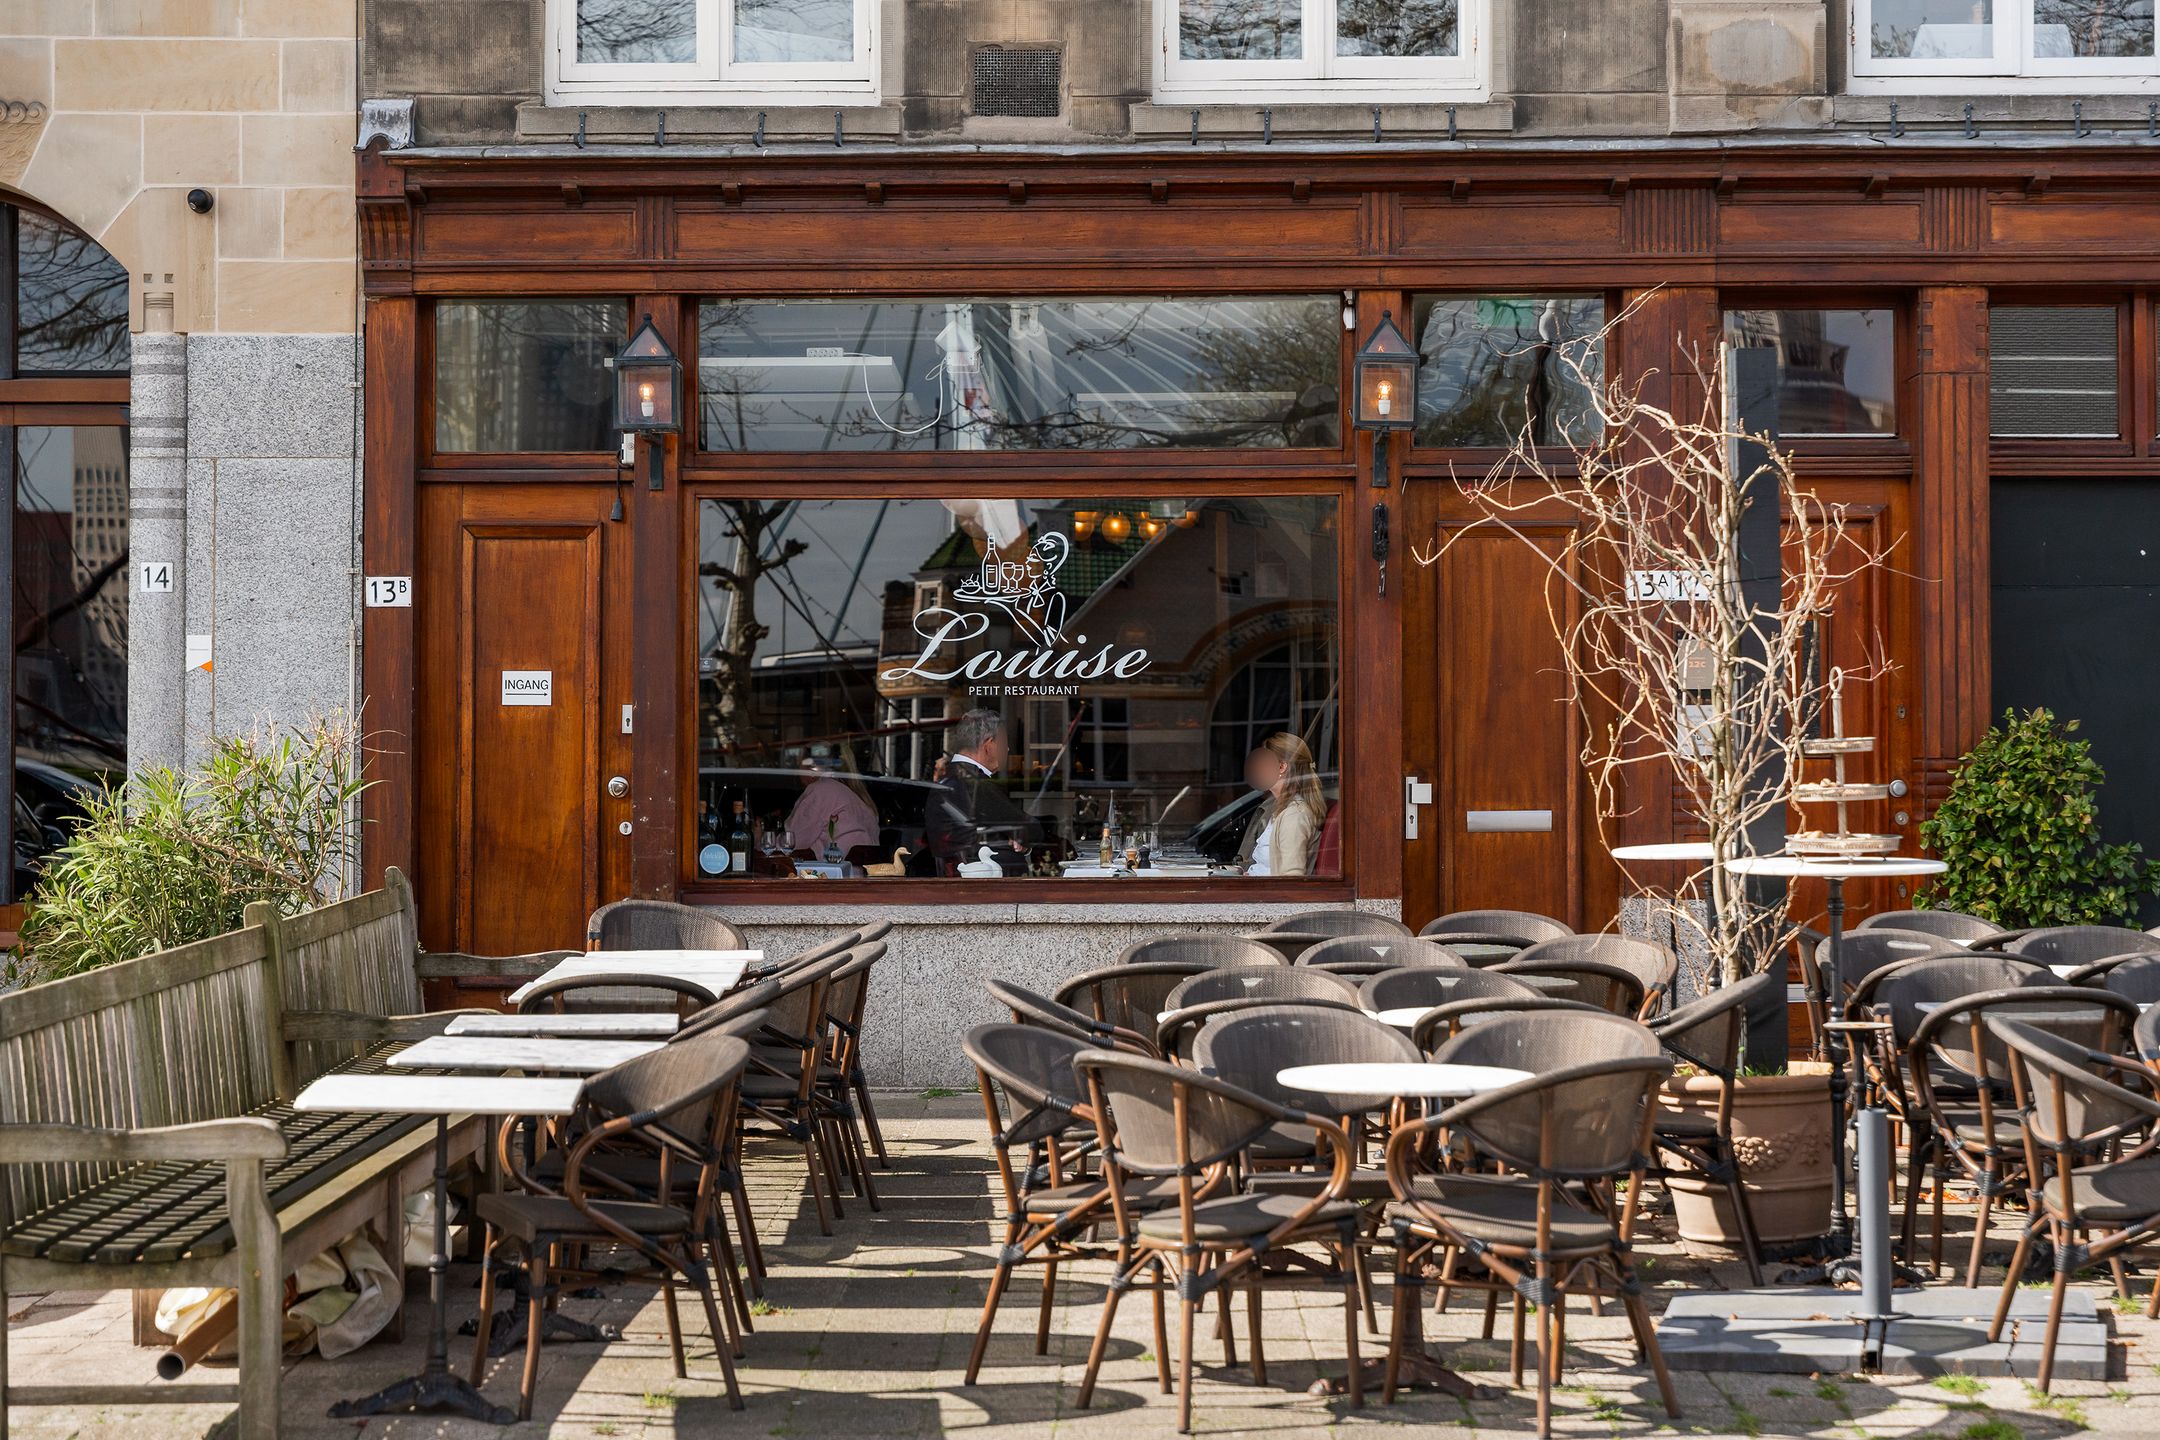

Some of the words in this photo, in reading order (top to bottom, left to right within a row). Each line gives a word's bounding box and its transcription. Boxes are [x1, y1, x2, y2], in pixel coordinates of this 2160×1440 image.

[144, 566, 170, 589] 14
[370, 580, 408, 604] 13B
[880, 607, 1152, 681] Louise
[504, 679, 549, 690] INGANG
[968, 686, 1000, 696] PETIT
[1004, 685, 1080, 696] RESTAURANT
